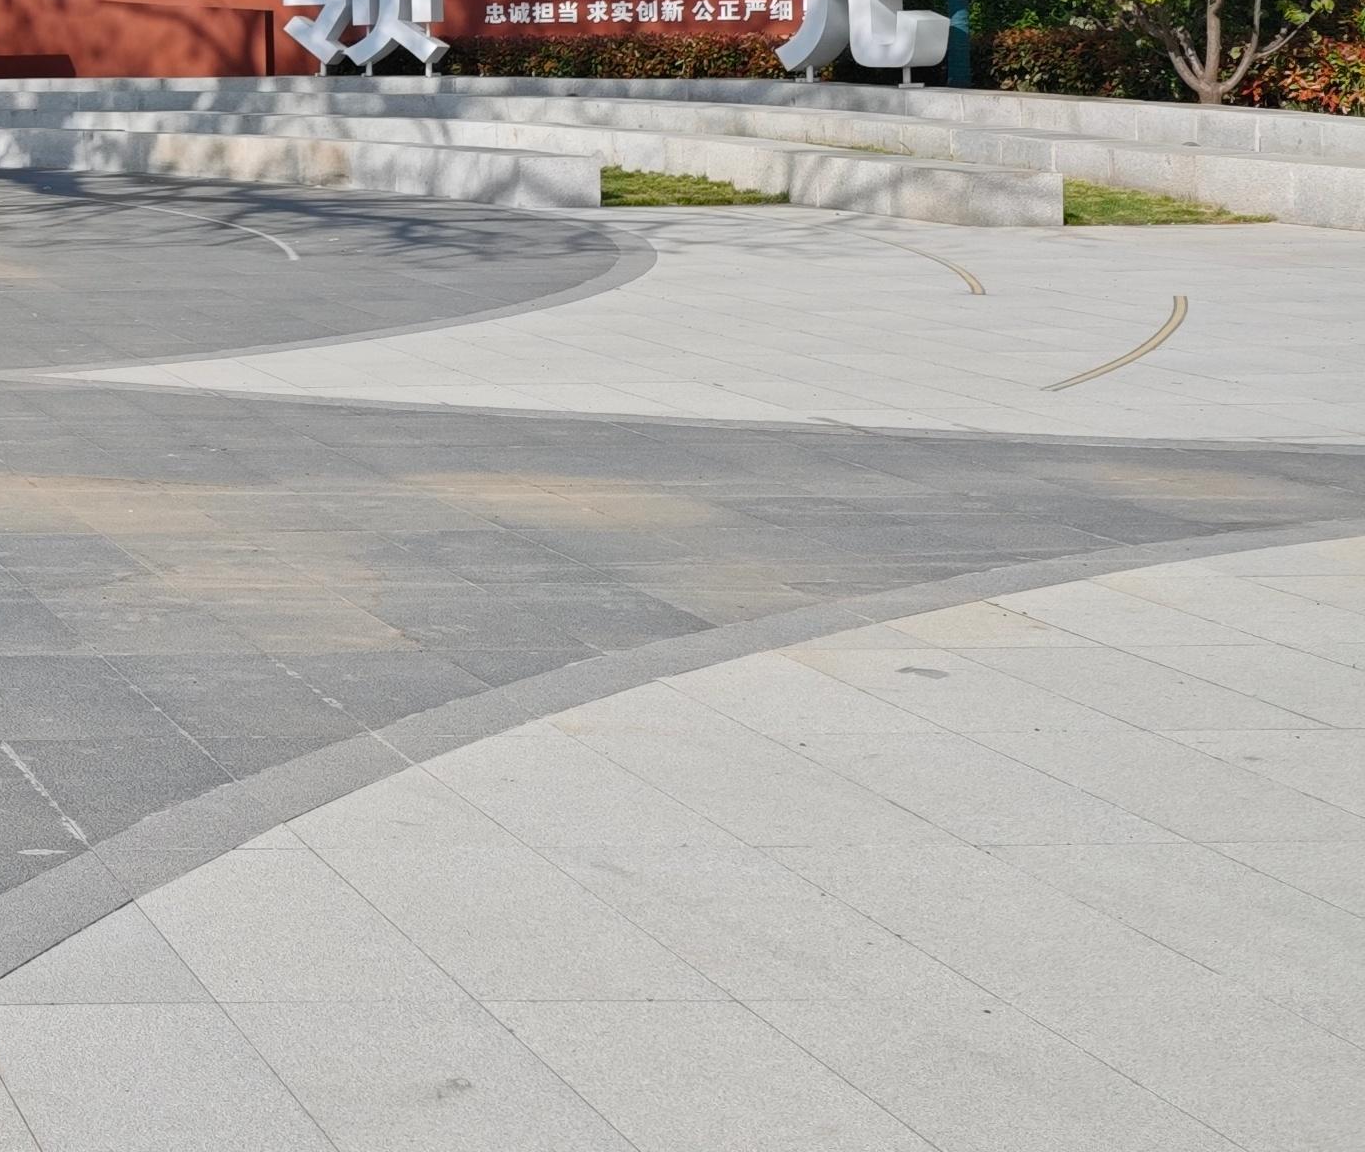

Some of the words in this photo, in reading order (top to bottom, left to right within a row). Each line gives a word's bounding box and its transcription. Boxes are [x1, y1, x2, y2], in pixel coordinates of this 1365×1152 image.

[484, 1, 579, 24] 忠诚担当
[586, 0, 685, 23] 求实创新
